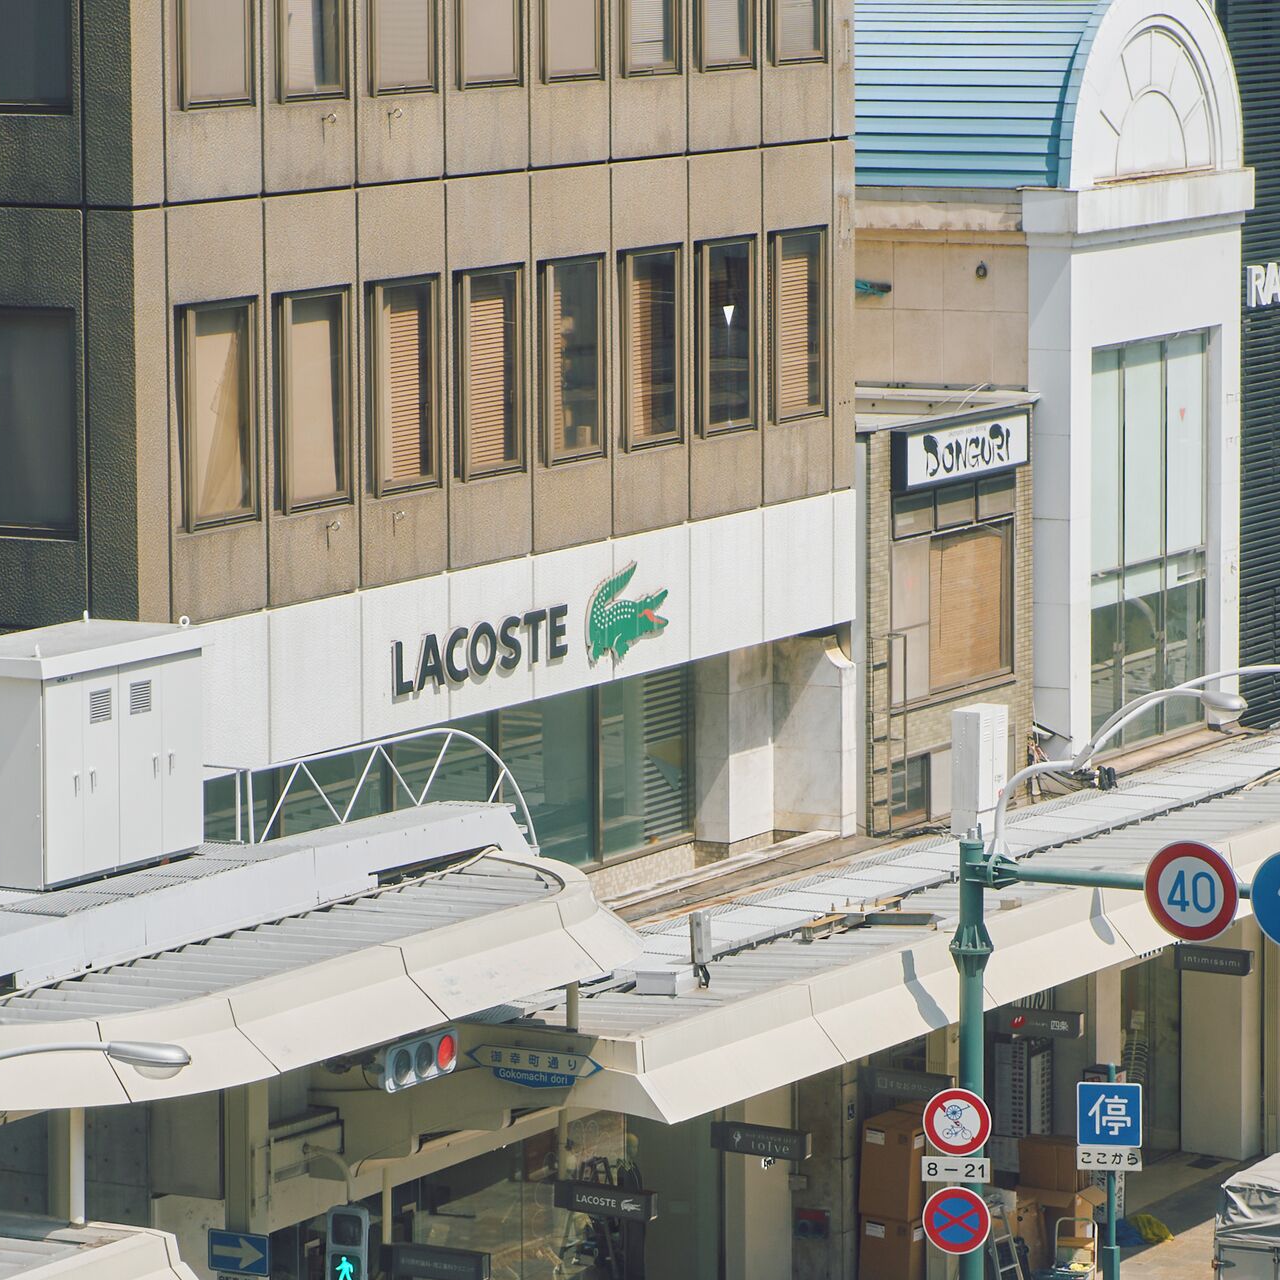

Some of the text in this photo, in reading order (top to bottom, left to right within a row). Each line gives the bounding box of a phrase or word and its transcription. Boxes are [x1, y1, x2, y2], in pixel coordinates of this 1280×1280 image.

[391, 602, 569, 699] LACOSTE
[1167, 870, 1216, 914] 40
[1183, 955, 1242, 968] intimissimi
[491, 1050, 577, 1071] 御幸町通り
[499, 1068, 568, 1085] Gokomachi dori
[1088, 1094, 1132, 1135] 停
[1081, 1151, 1139, 1166] ここから
[576, 1193, 617, 1208] LACOSTE
